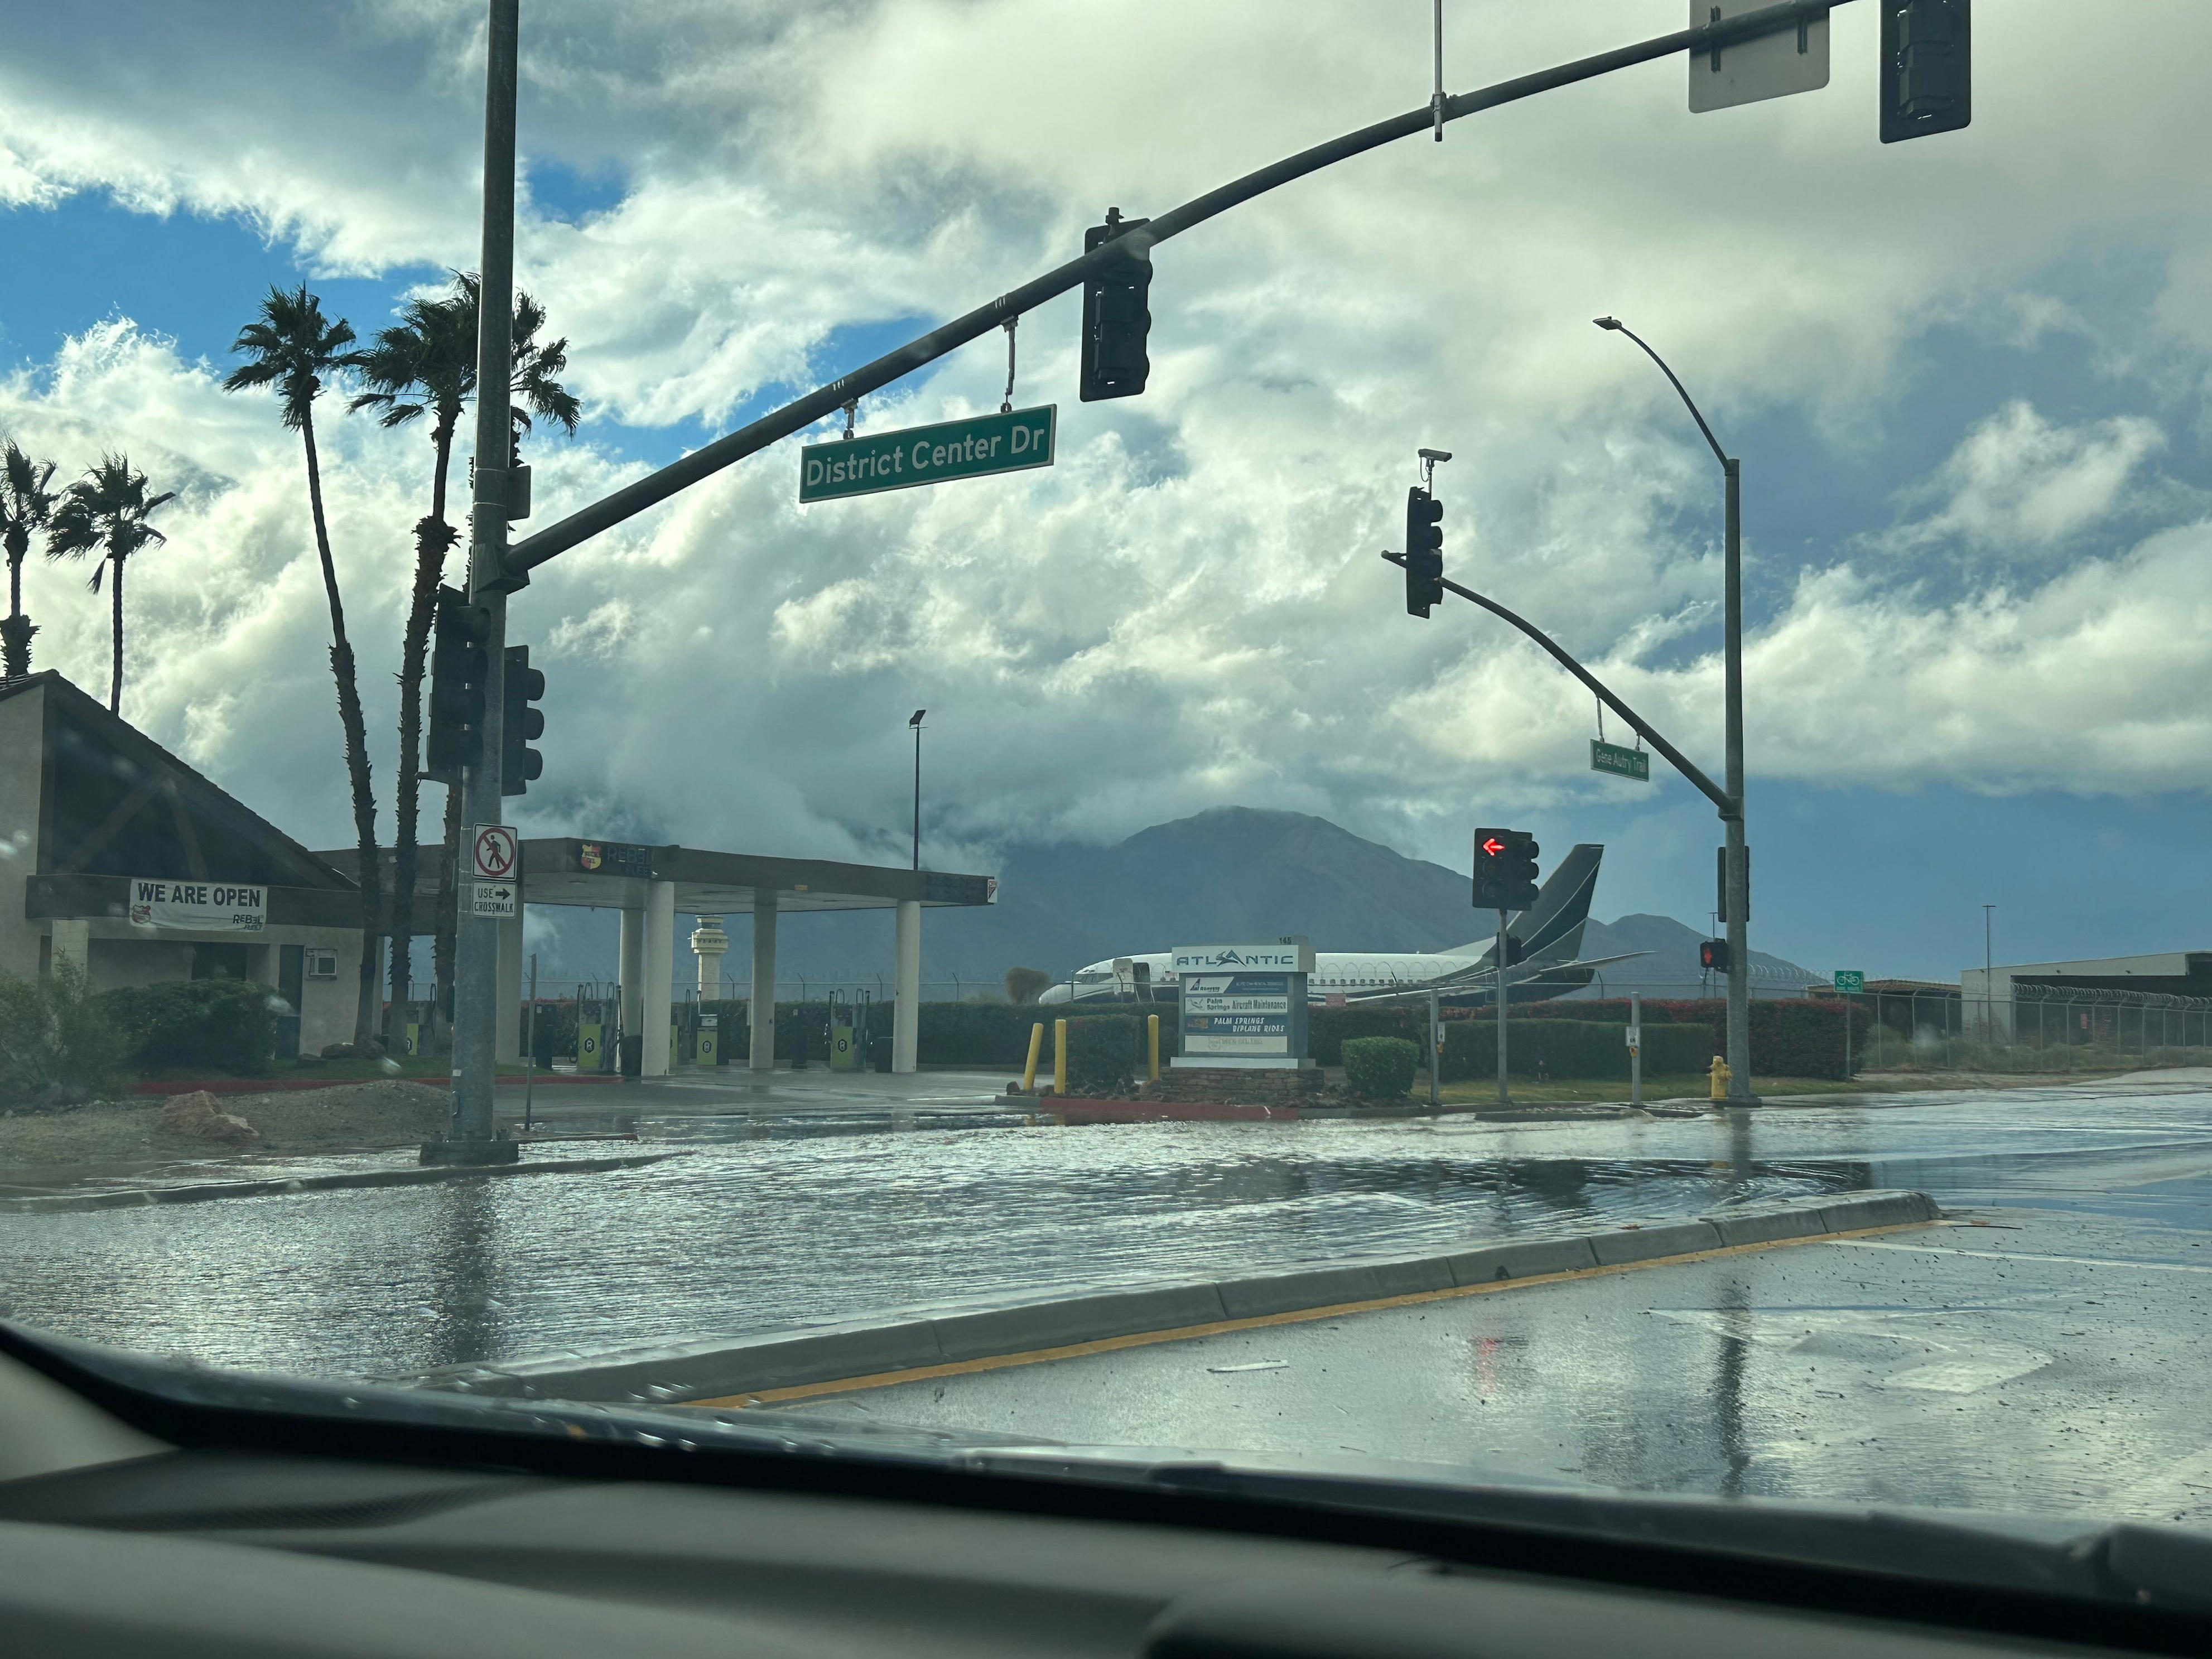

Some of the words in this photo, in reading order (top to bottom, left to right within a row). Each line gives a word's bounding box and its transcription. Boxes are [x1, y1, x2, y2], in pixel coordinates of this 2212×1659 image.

[807, 446, 903, 487] District
[912, 433, 1002, 470] Center
[1010, 425, 1045, 455] Dr
[138, 883, 166, 902] WE
[171, 885, 208, 904] ARE
[213, 888, 261, 907] OPEN
[478, 888, 494, 898] USE
[474, 901, 514, 913] CROSSWALK
[1176, 949, 1294, 967] ATLANTIC
